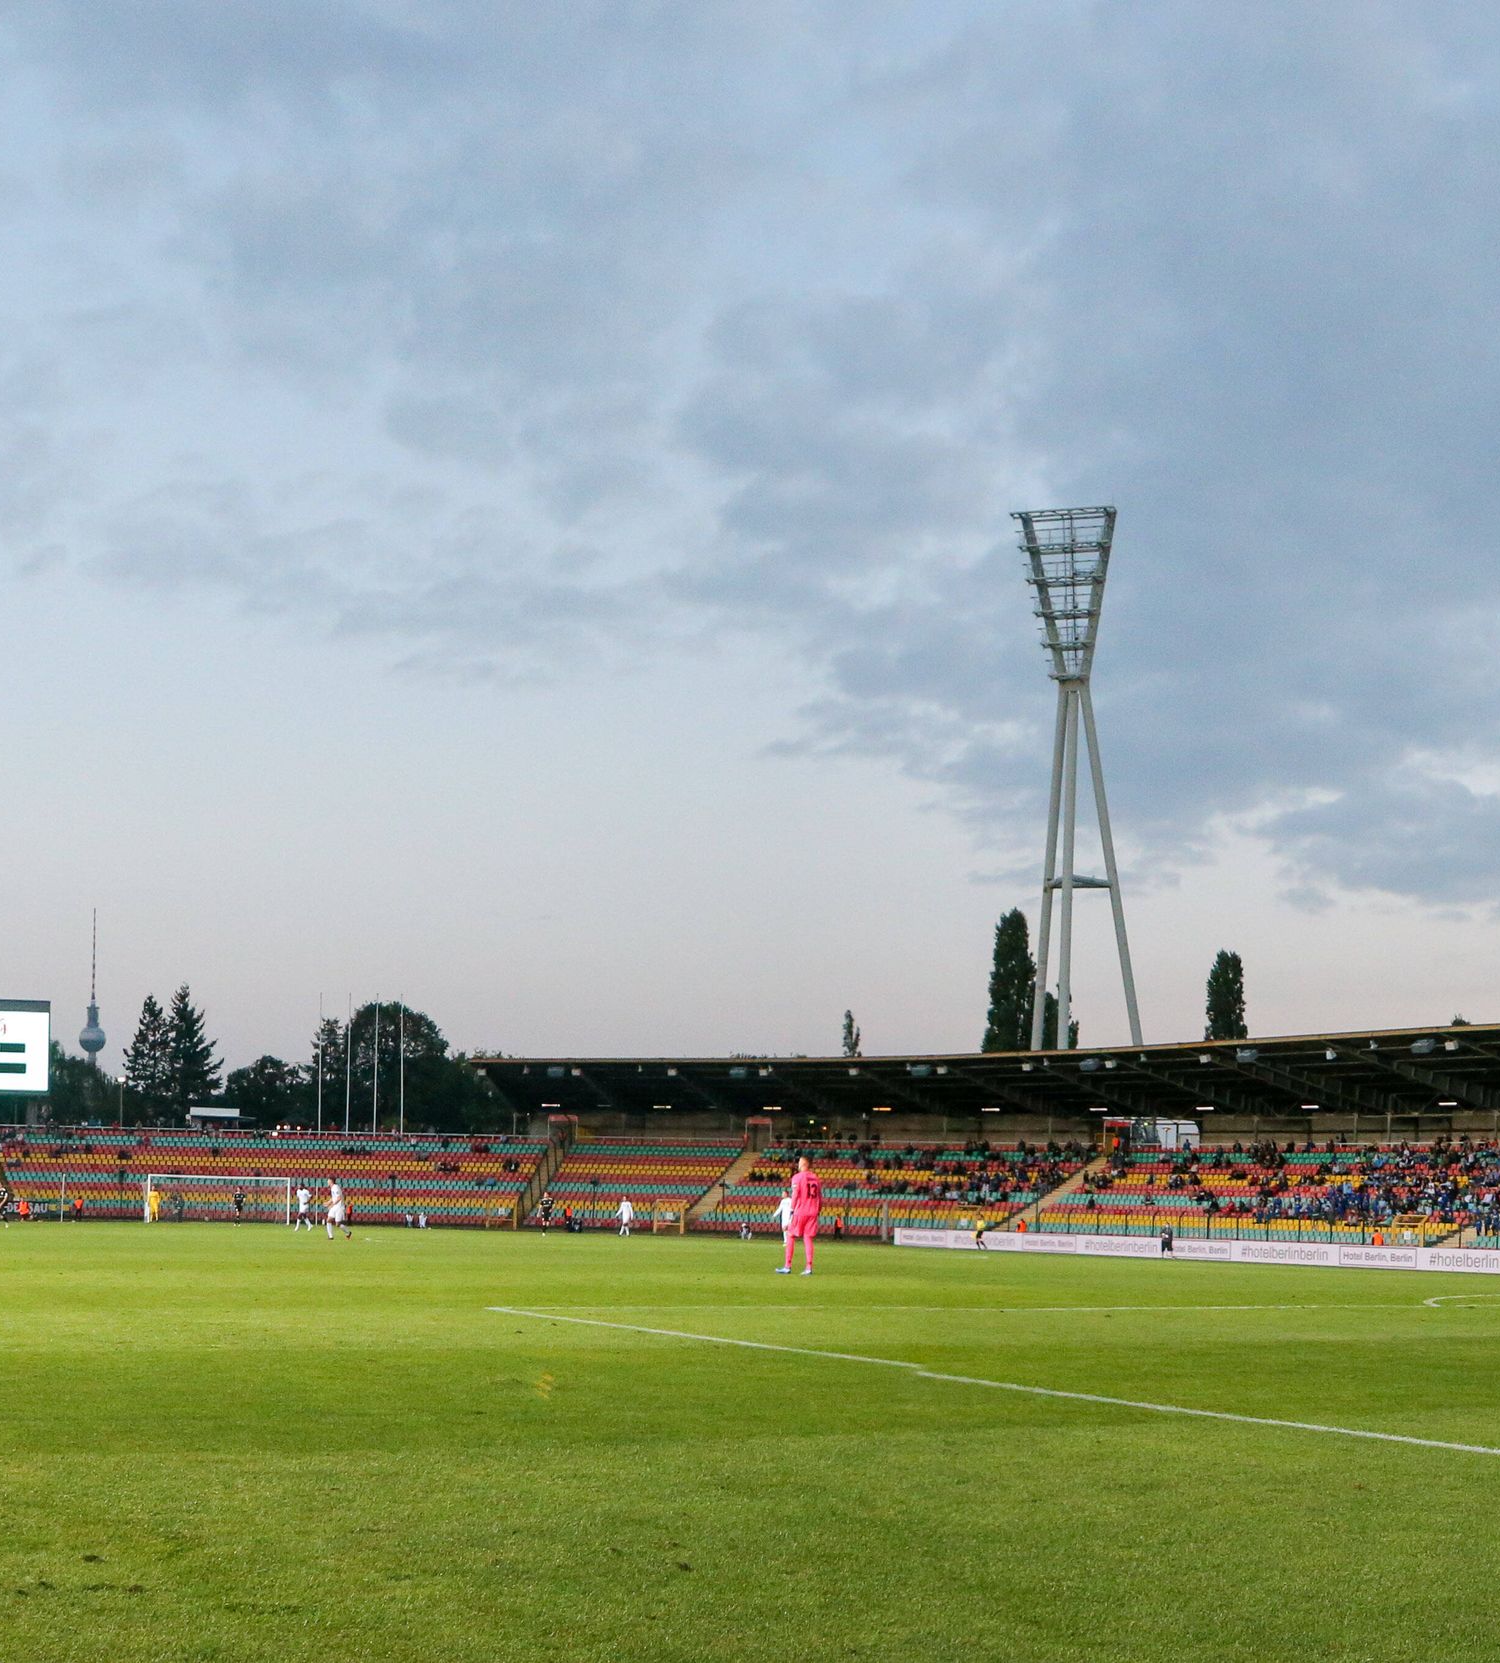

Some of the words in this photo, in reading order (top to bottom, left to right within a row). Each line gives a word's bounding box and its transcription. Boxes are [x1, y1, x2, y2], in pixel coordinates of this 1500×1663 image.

[807, 1183, 818, 1199] 13
[1241, 1246, 1329, 1261] #hotelberlinberlin
[1343, 1251, 1363, 1260] Hotel
[1364, 1252, 1389, 1263] Berlin,
[1390, 1253, 1413, 1262] Berlin
